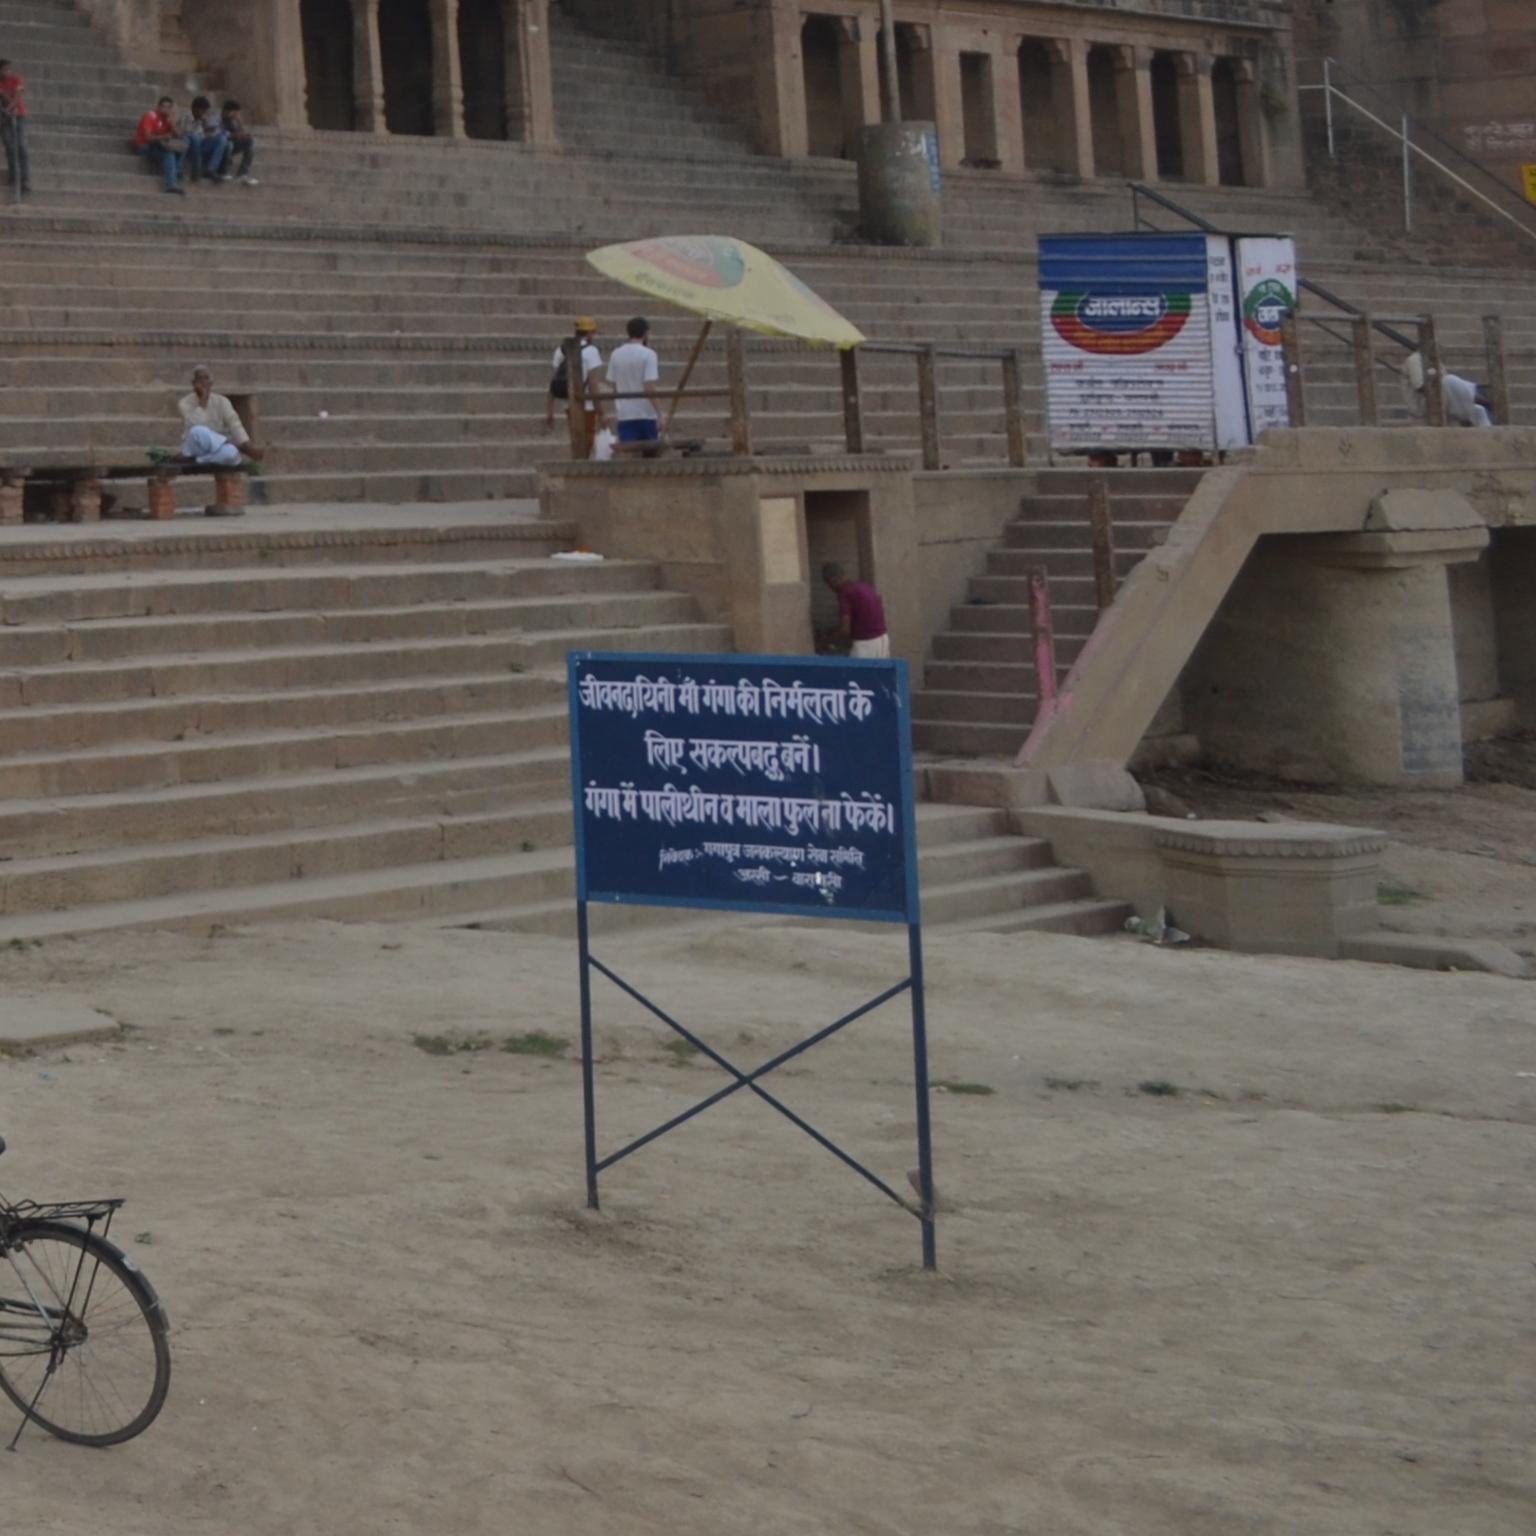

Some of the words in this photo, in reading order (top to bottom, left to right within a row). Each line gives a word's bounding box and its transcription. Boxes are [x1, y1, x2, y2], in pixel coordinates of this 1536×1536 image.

[702, 679, 736, 714] गंगा
[736, 678, 761, 716] की
[762, 678, 847, 724] निर्मलता
[847, 681, 875, 721] के
[644, 729, 687, 774] लिए
[584, 780, 622, 821] गंगा
[620, 781, 638, 820] में
[639, 782, 719, 828] पालीथीन
[720, 794, 734, 825] व
[736, 795, 783, 831] माला
